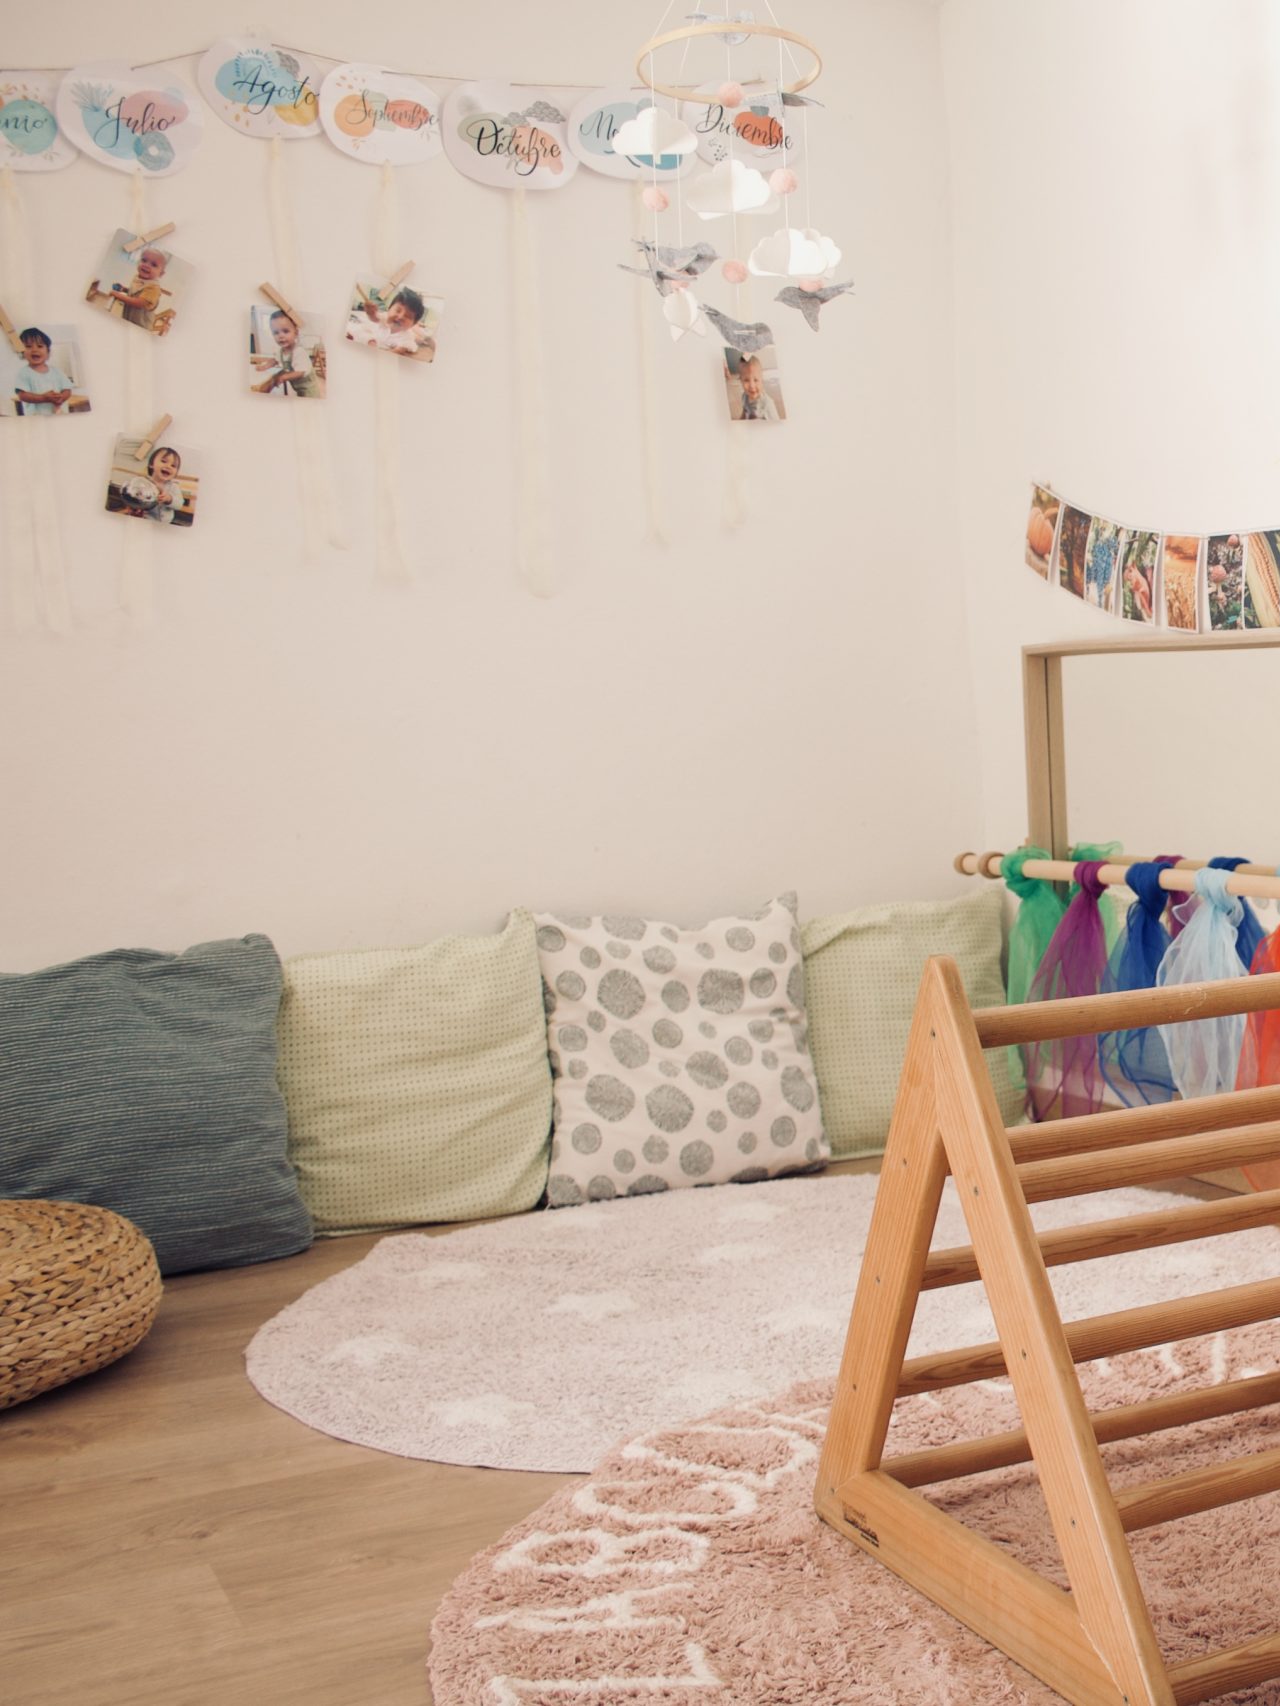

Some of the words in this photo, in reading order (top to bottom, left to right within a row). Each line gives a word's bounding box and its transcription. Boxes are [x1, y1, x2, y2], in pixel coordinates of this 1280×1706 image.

[232, 64, 320, 115] Agosto
[94, 96, 176, 149] Julio
[467, 118, 562, 176] Octubre
